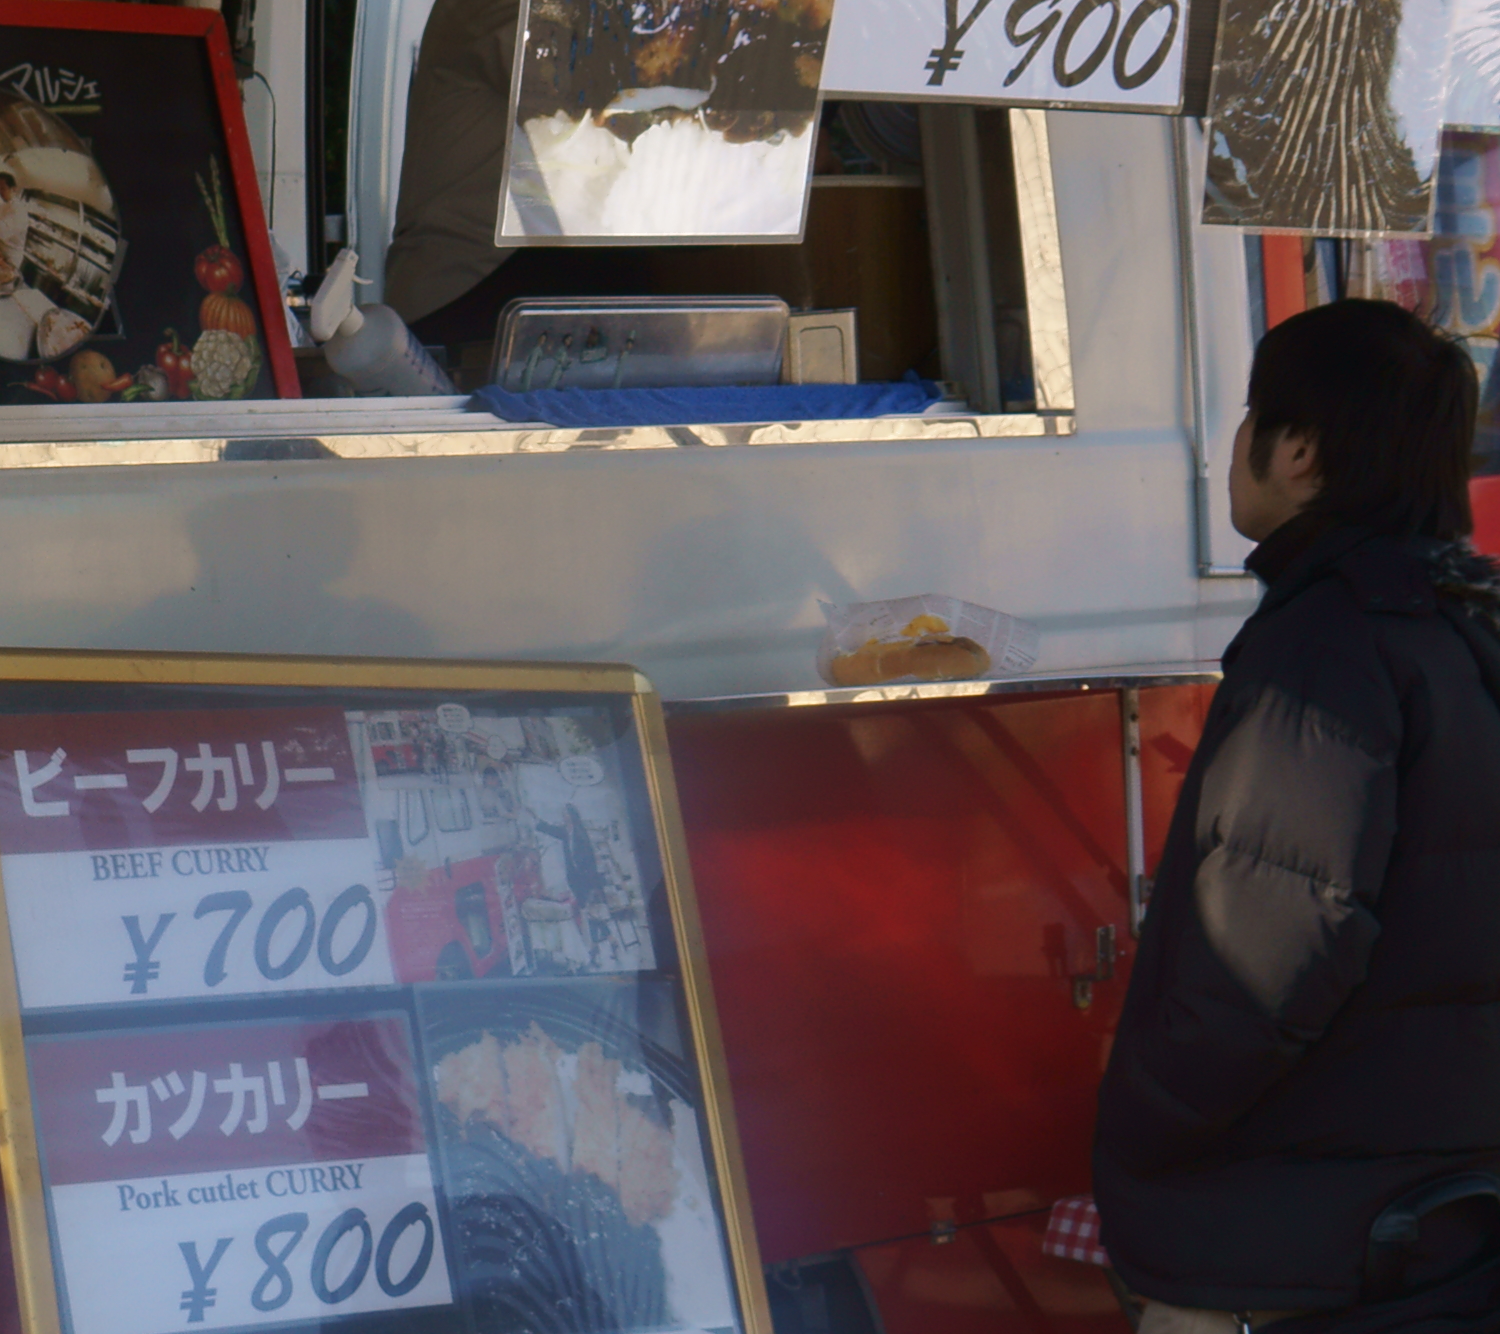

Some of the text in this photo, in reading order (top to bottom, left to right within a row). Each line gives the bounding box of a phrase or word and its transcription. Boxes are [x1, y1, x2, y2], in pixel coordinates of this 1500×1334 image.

[14, 742, 334, 816] ビーフカリー
[92, 845, 270, 883] BEEF CURRY
[122, 884, 377, 994] ¥700
[95, 1057, 369, 1147] カツカリー
[119, 1163, 365, 1213] Pork cutlet CURRY
[178, 1201, 434, 1322] ¥800
